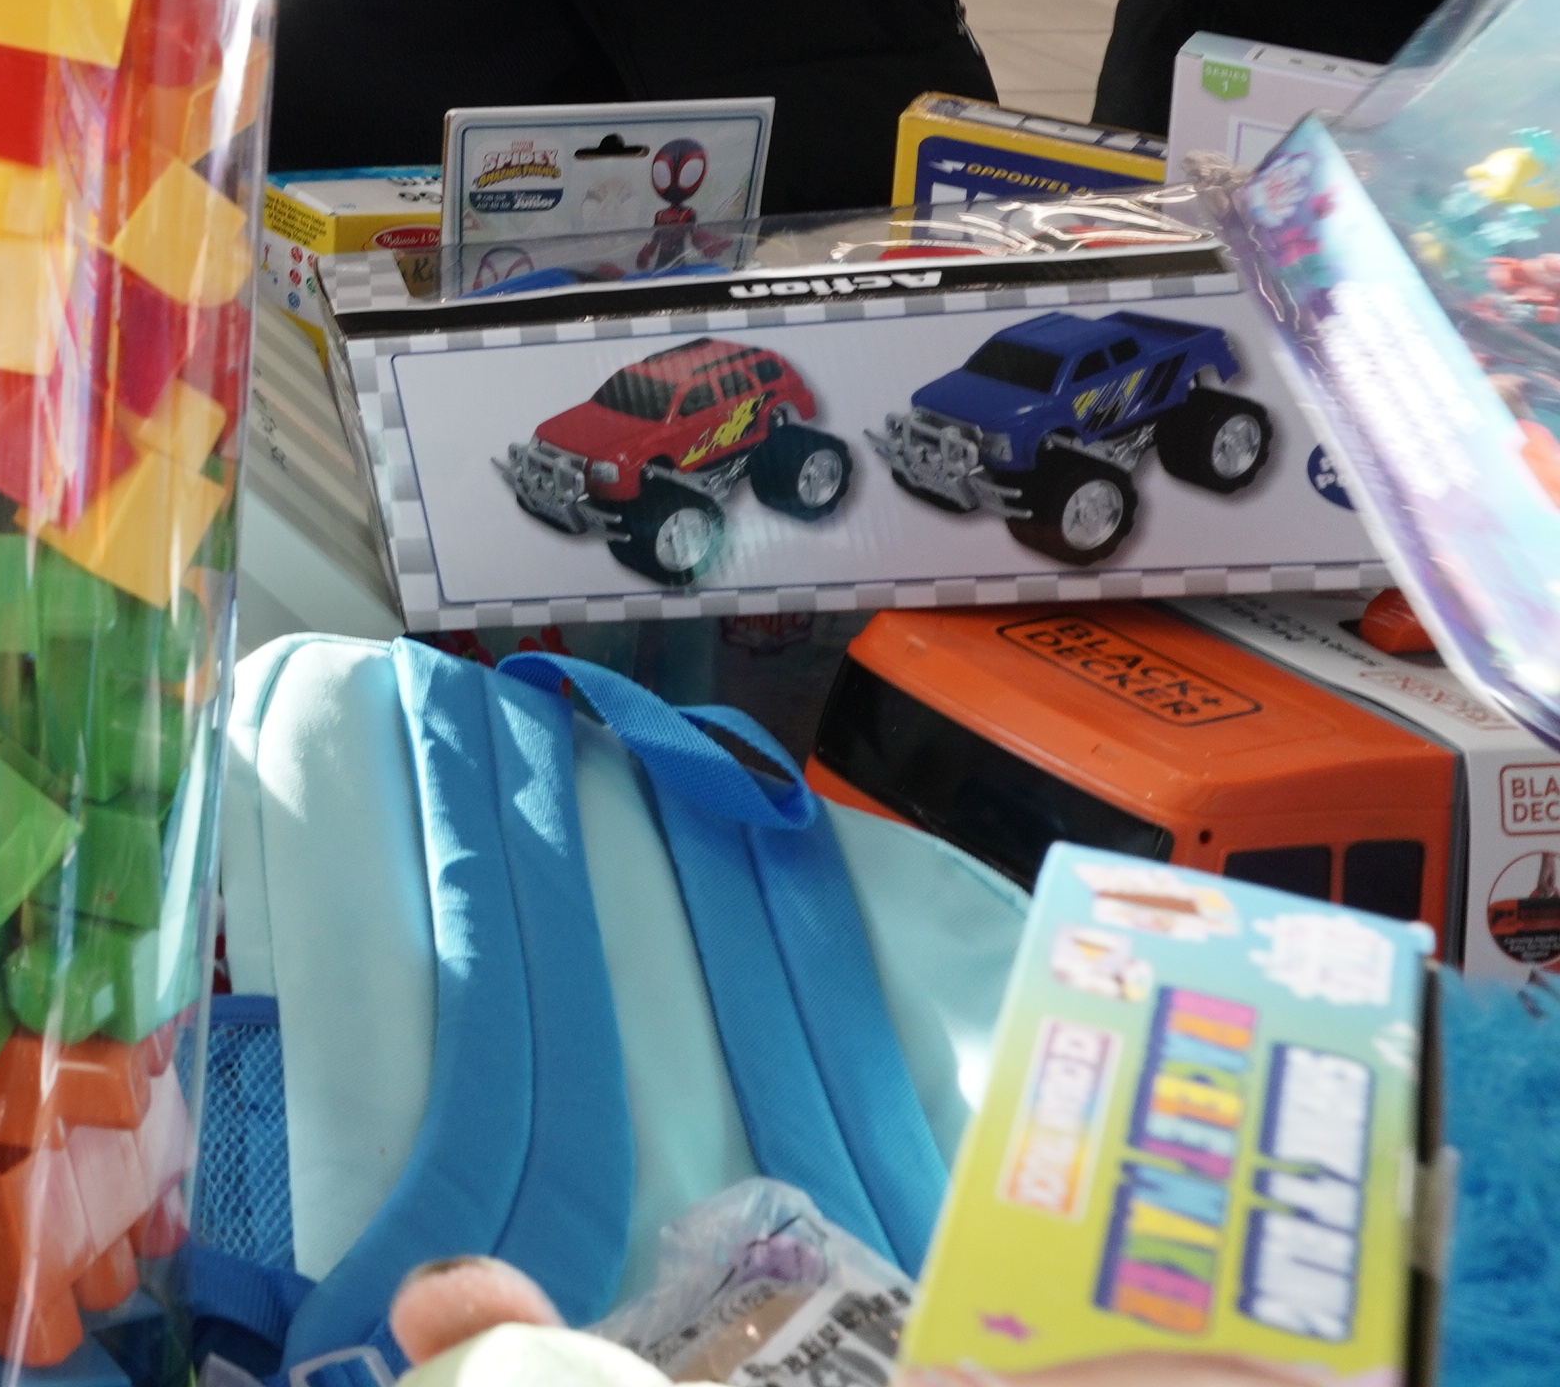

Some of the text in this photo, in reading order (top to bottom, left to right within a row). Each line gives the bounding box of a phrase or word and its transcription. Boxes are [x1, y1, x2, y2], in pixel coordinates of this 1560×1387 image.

[1204, 65, 1249, 81] SERIES
[1221, 81, 1230, 93] 1
[481, 148, 560, 173] SPIDEY
[965, 162, 1071, 193] OPPOSITES
[512, 195, 556, 211] Junior
[380, 231, 420, 250] Melissa
[728, 270, 943, 299] Action
[1023, 629, 1201, 724] DECKER
[1052, 619, 1224, 713] BLACK+
